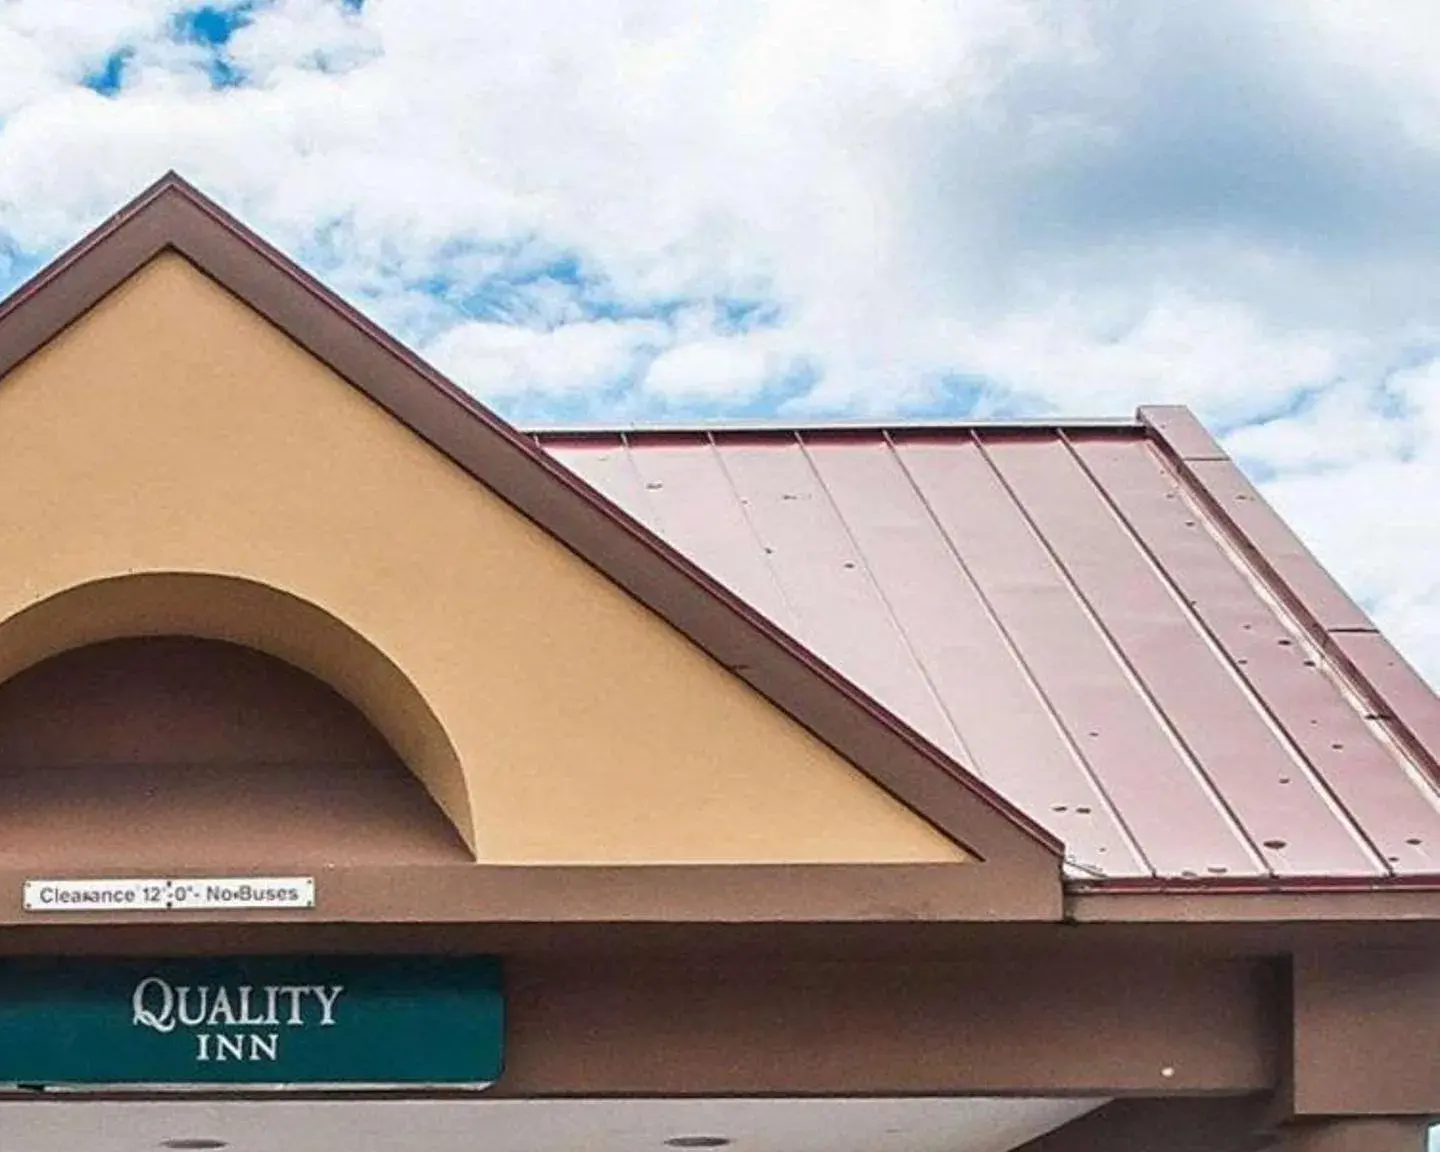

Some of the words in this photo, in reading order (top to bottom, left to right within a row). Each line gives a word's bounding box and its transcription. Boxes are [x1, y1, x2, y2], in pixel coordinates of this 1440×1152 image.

[39, 886, 136, 904] Clearance
[132, 976, 344, 1033] QUALITY
[196, 1033, 279, 1061] INN
